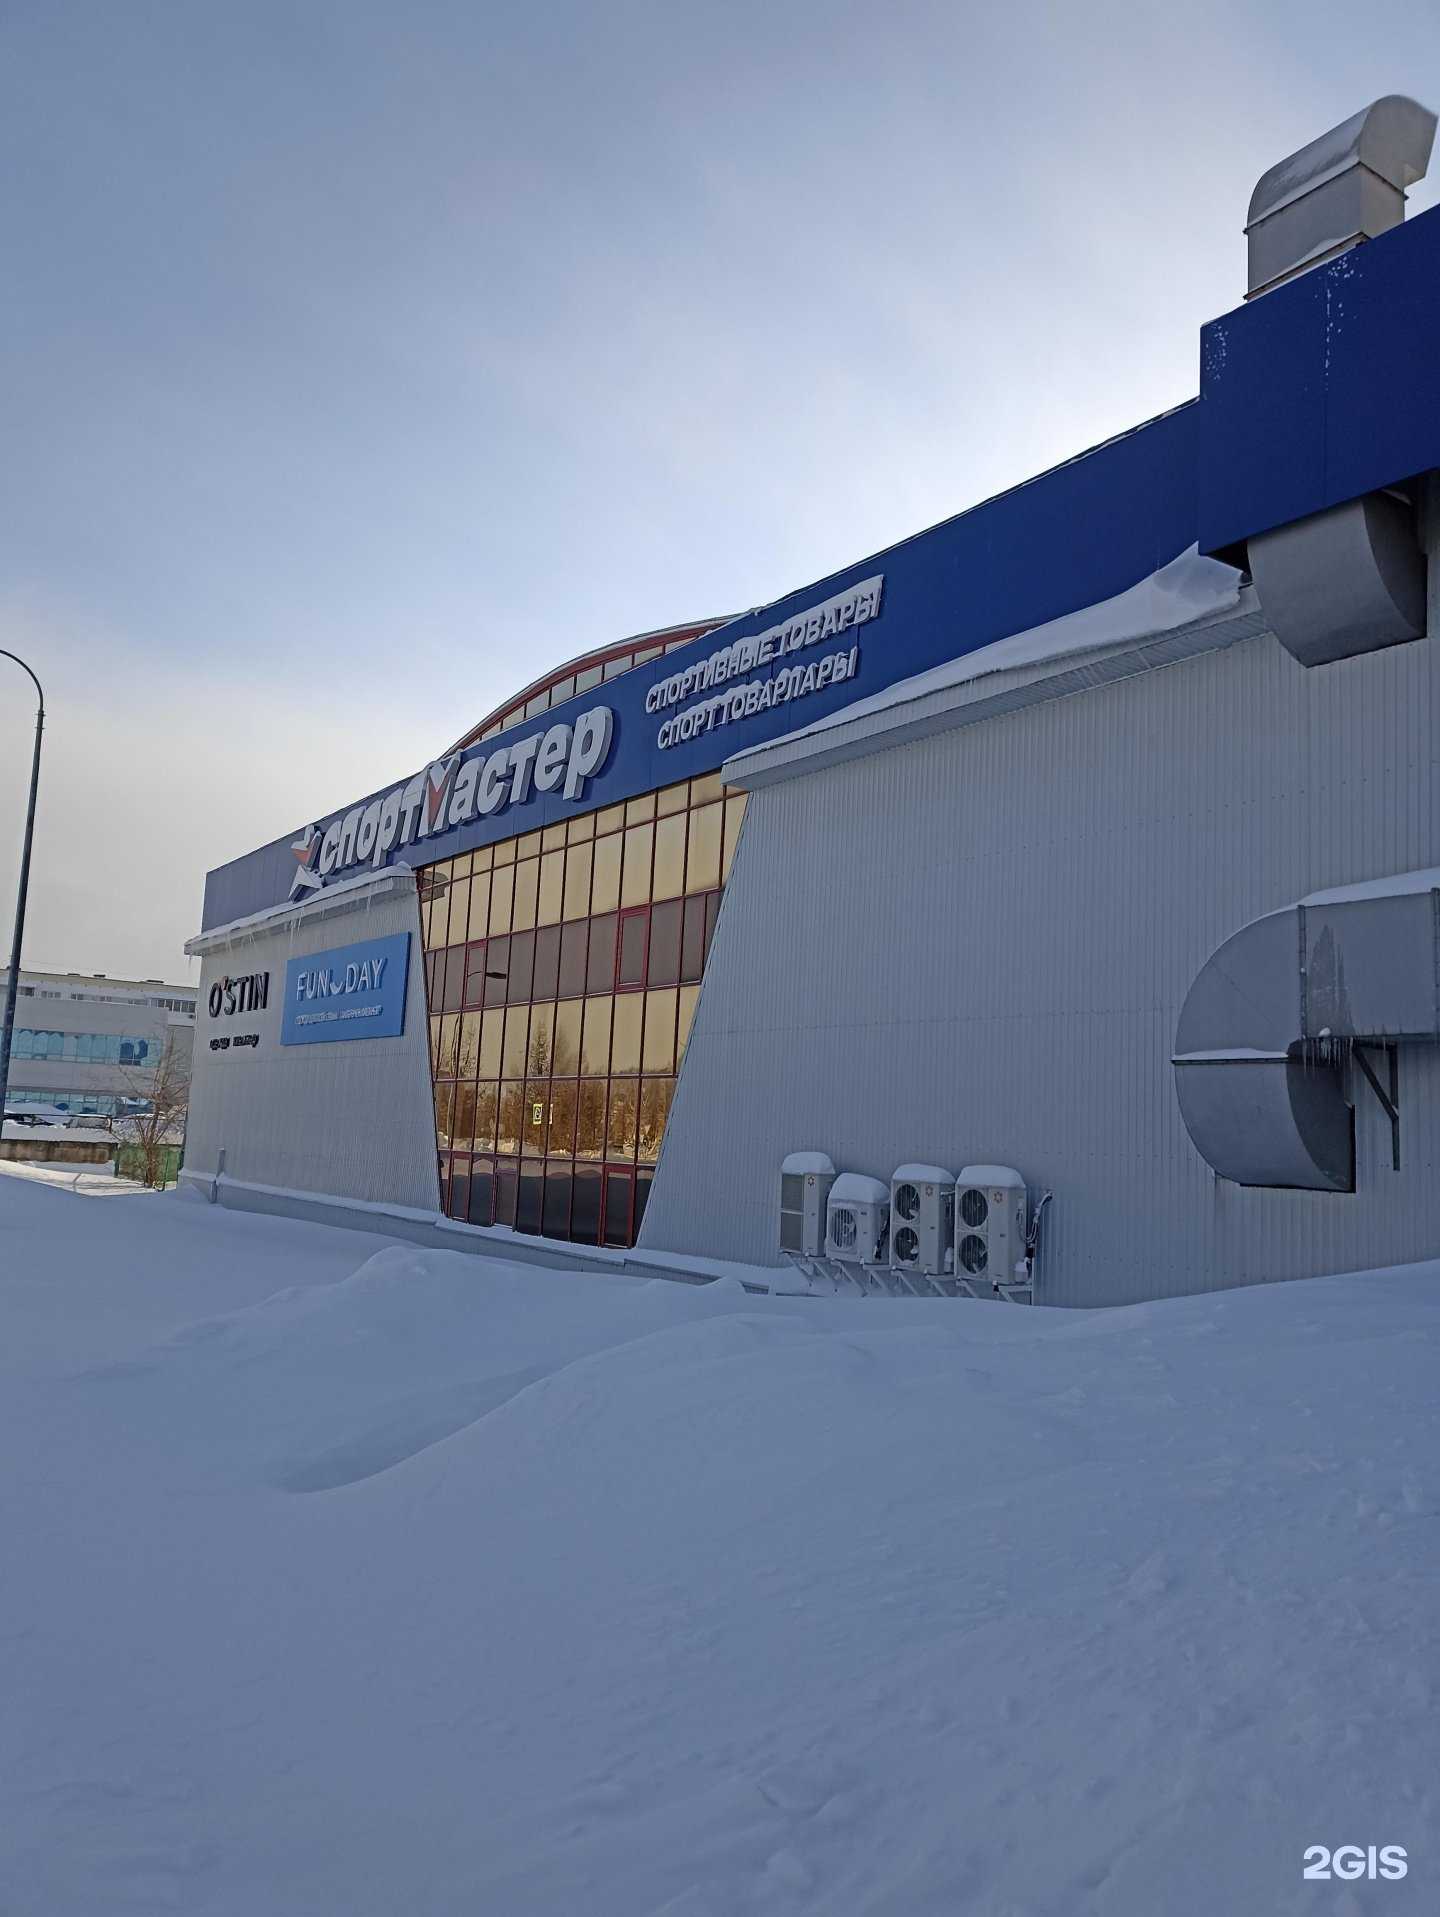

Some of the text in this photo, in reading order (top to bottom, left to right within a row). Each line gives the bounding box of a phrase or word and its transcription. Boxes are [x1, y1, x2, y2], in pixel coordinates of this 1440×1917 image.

[646, 576, 884, 714] СПОРТИВНЫЕ ТОВАРЫ
[209, 971, 270, 1018] O'STIN
